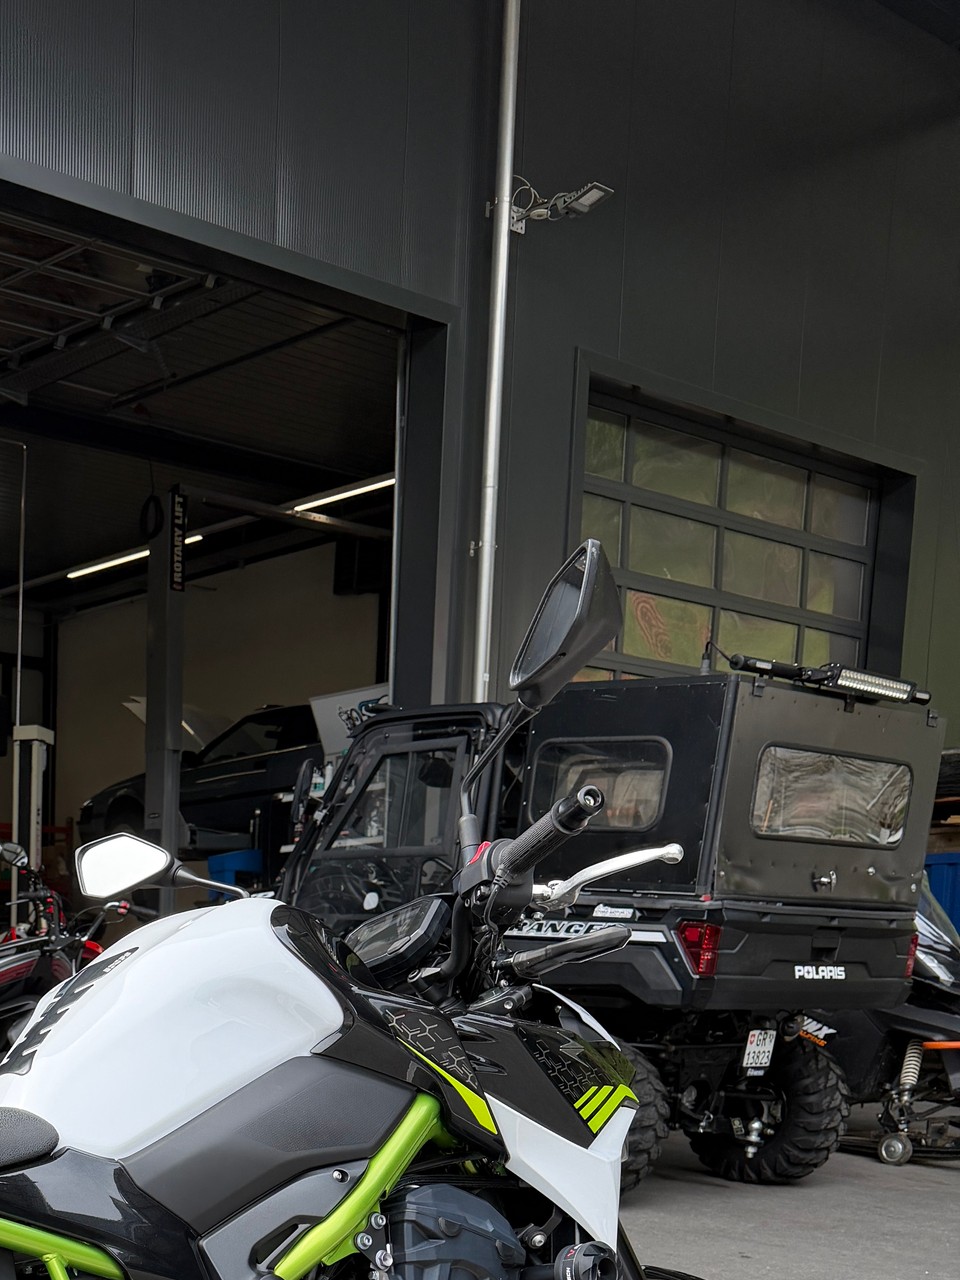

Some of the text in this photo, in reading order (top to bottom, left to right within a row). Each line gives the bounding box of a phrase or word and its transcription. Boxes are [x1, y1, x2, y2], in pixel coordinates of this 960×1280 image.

[173, 494, 184, 582] ROTARY LIFT
[505, 920, 626, 937] RANGE
[794, 965, 846, 980] POLARIS
[755, 1031, 768, 1047] GR
